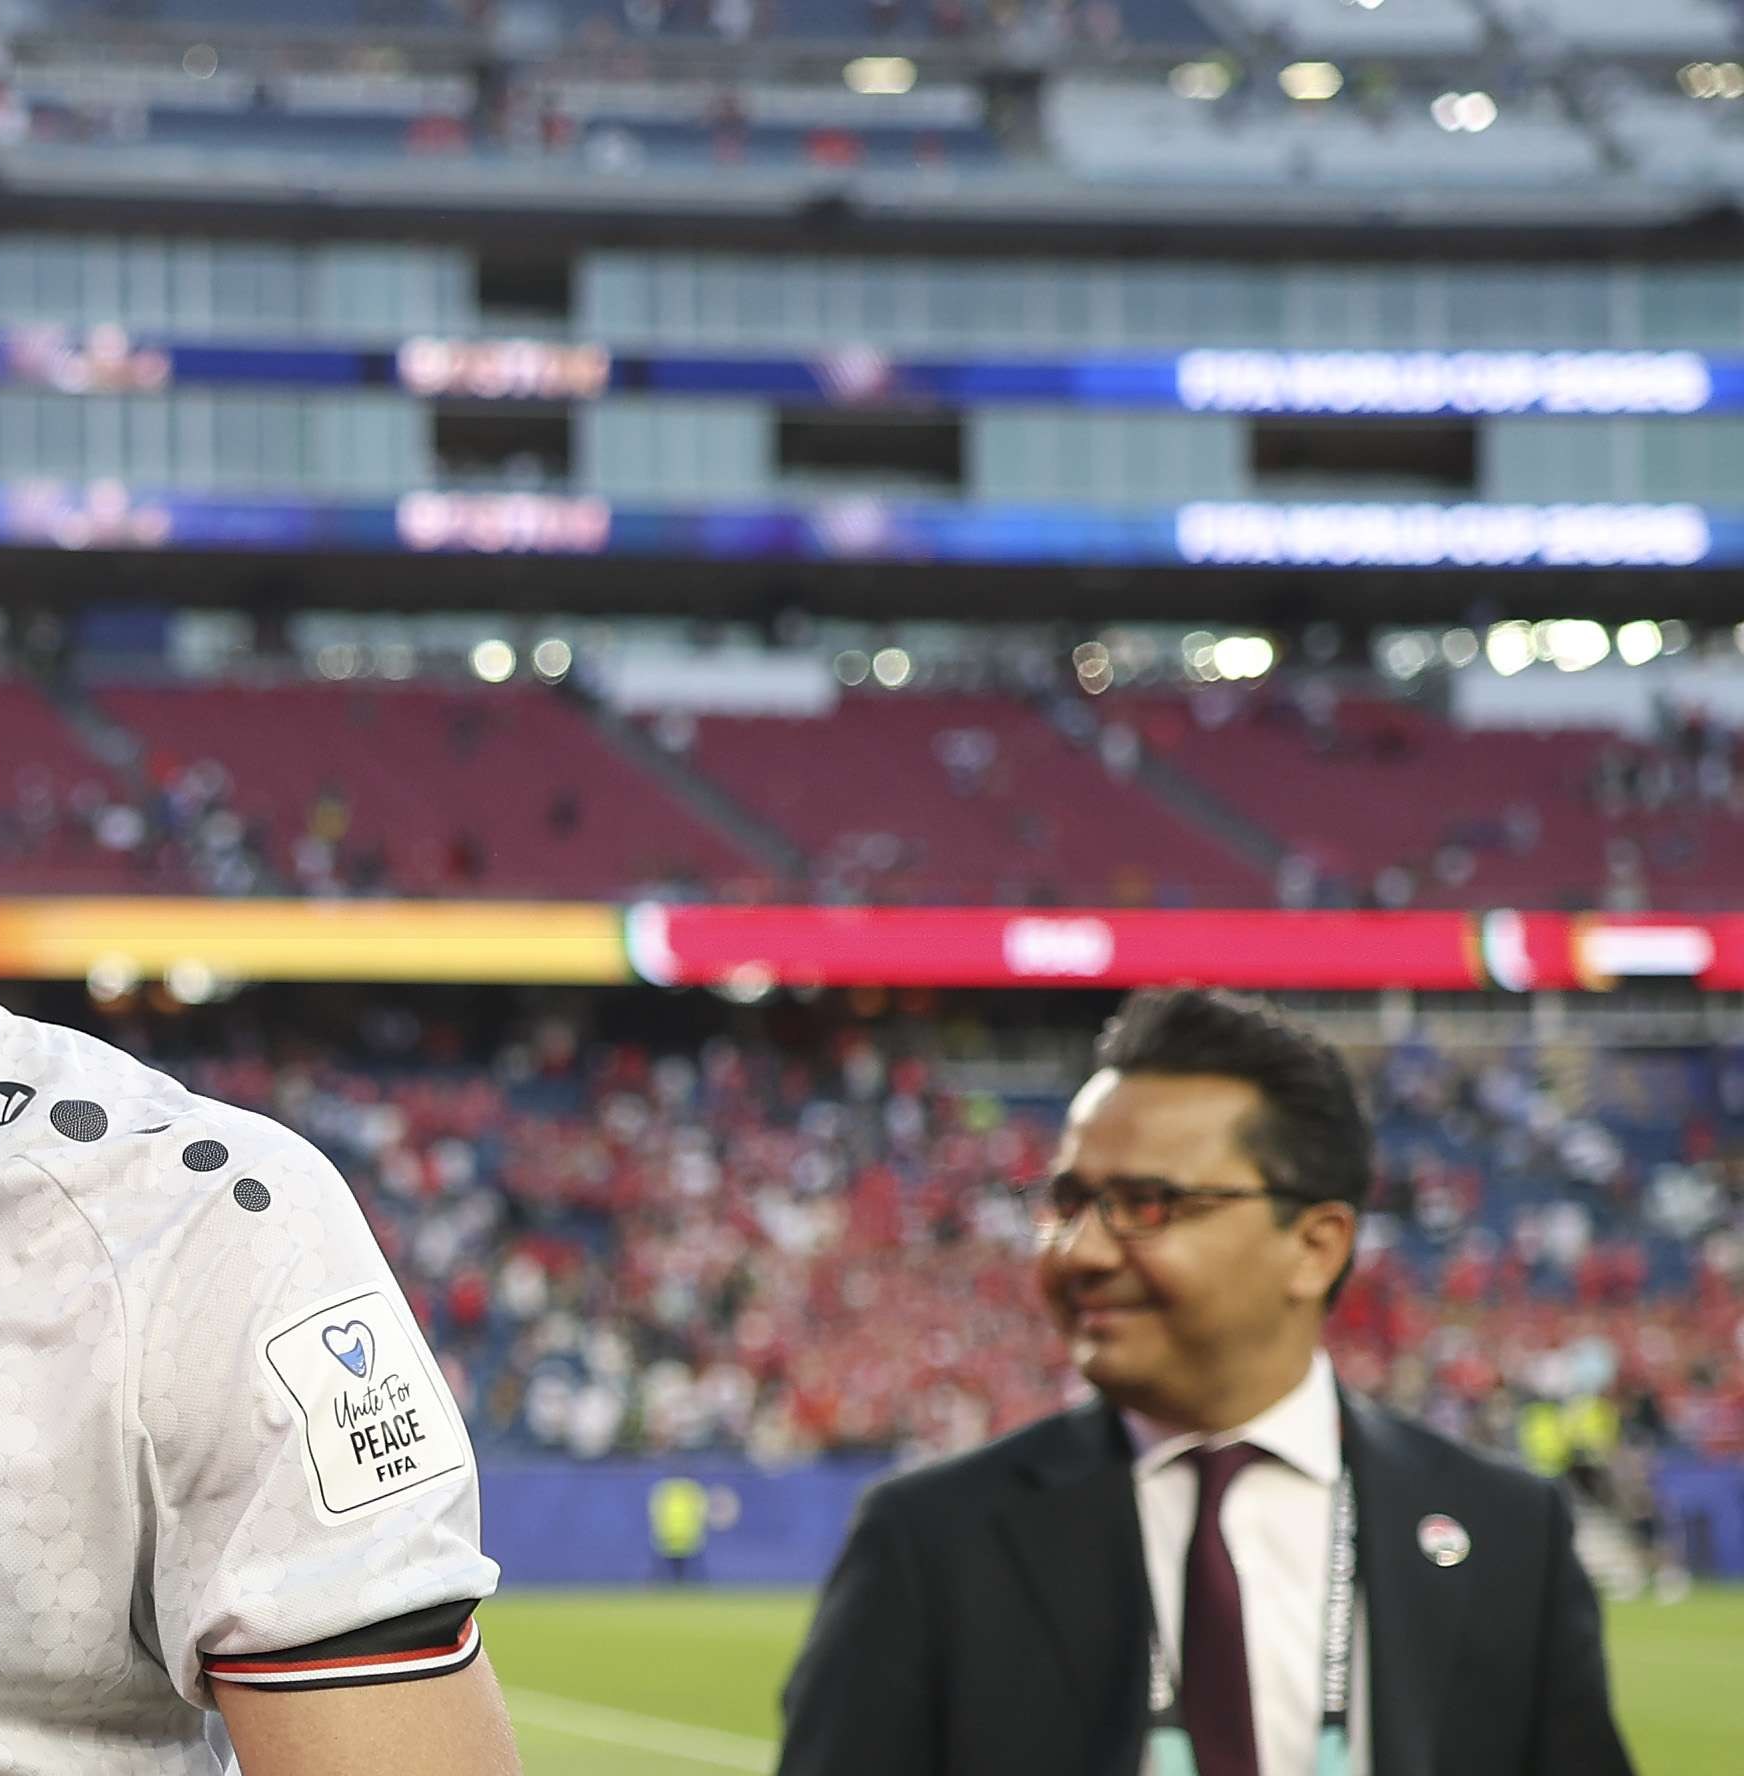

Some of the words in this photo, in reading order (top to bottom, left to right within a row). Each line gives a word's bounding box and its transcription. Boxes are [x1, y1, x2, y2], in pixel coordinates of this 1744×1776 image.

[334, 1386, 384, 1430] Unite
[379, 1373, 411, 1411] For
[349, 1408, 427, 1466] PEACE
[375, 1456, 418, 1483] FIFA
